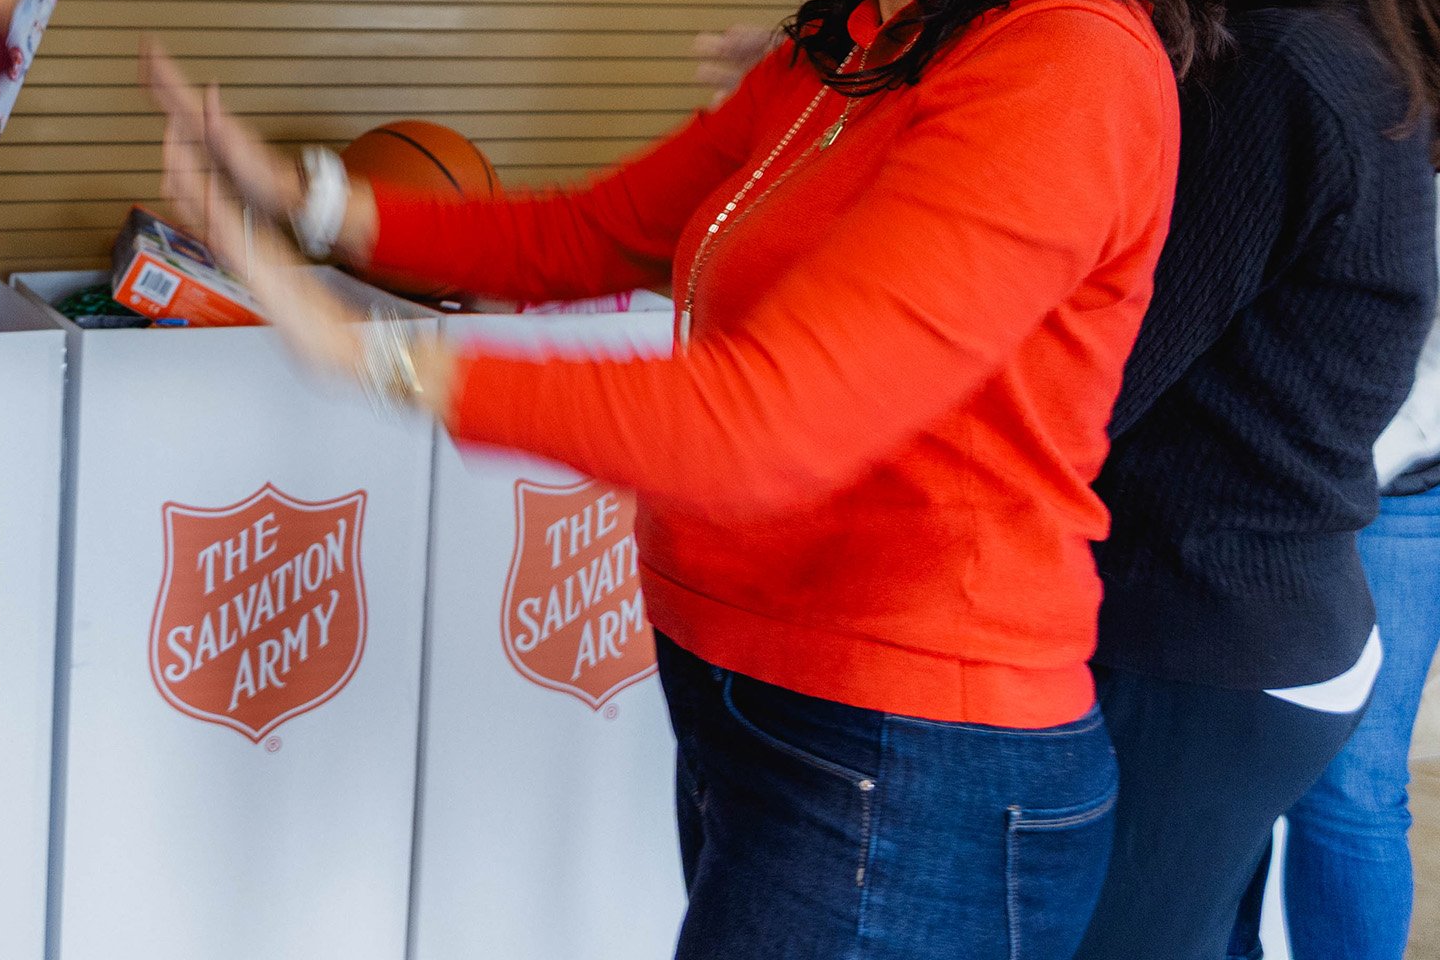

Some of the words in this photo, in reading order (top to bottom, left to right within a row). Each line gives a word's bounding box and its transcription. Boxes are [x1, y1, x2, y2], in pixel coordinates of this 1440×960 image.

[196, 511, 281, 597] THE
[545, 491, 620, 570] THE
[164, 518, 347, 682] SALVATION
[514, 531, 638, 654] SALVATI
[570, 586, 644, 681] ARM
[226, 589, 339, 713] ARMY
